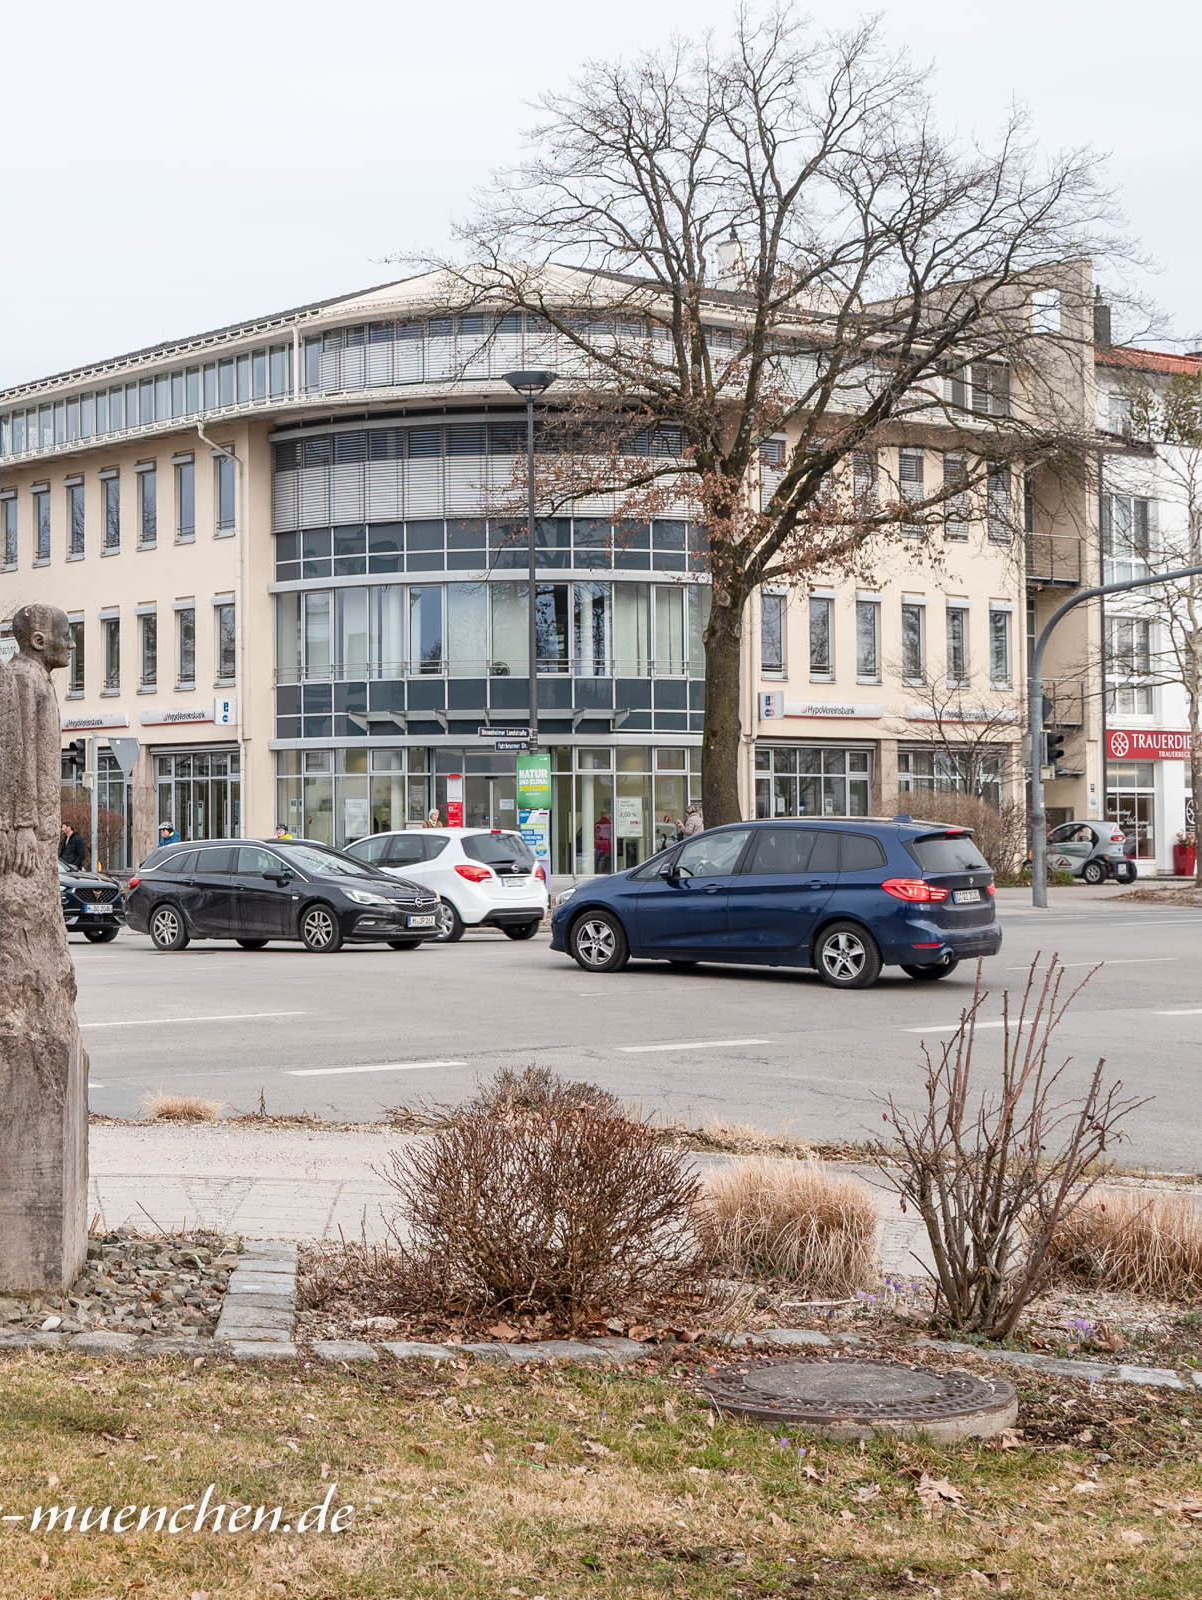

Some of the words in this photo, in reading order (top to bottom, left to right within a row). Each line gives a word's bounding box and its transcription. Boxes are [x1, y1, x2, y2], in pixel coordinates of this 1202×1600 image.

[807, 705, 856, 716] HypoVereinsbank
[166, 711, 206, 721] HypoVereinsbank
[1131, 734, 1192, 750] TRAUERDIE
[519, 769, 548, 779] NATUR
